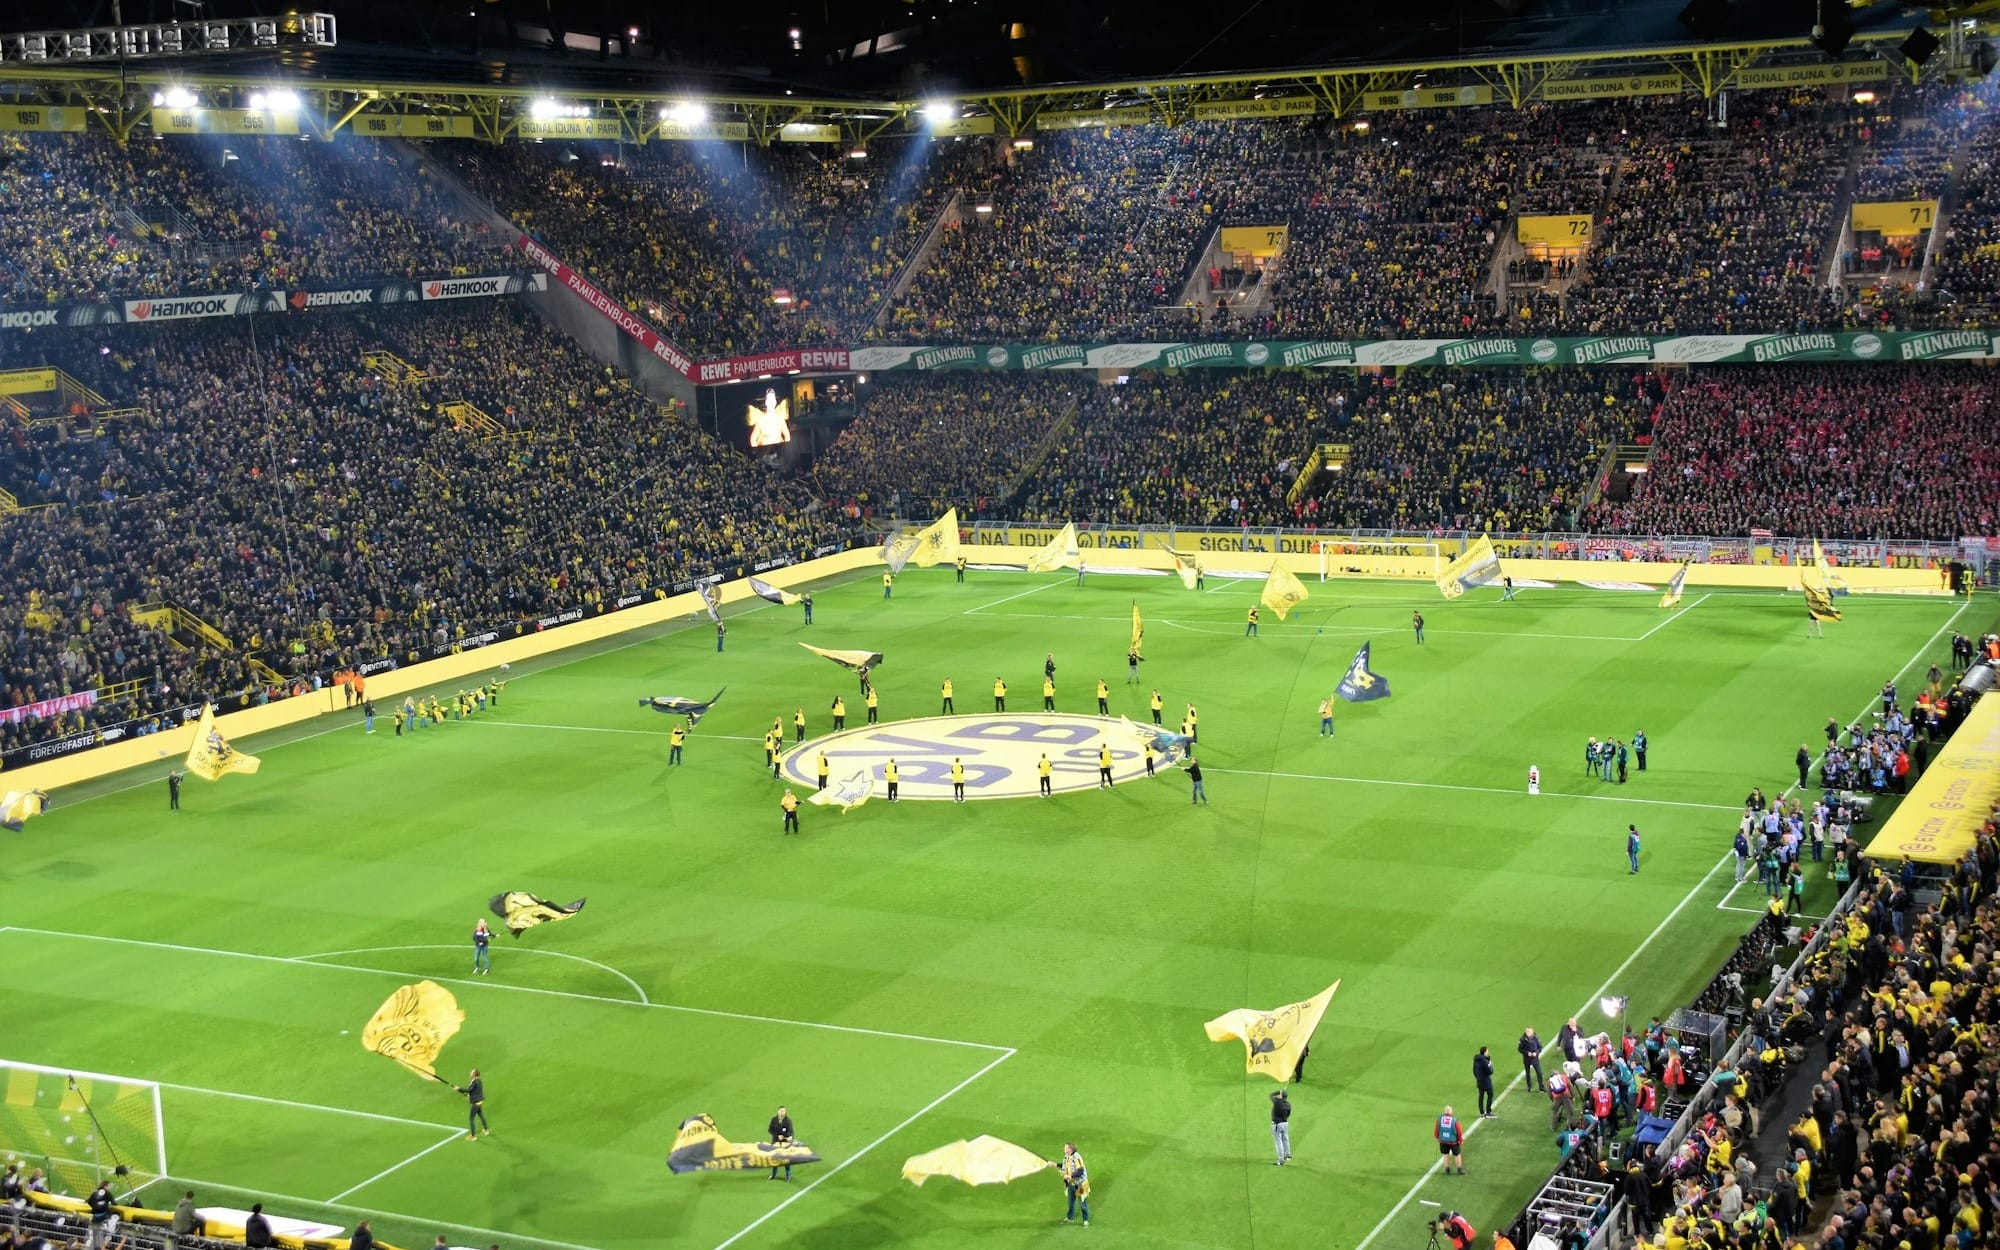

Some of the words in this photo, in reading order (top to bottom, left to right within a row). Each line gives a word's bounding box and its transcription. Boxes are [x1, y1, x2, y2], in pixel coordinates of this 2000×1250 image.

[1741, 74, 1784, 85] SIGNAL
[1788, 70, 1825, 81] IDUNA
[1850, 66, 1883, 77] PARK
[1547, 85, 1587, 95] SIGNAL
[1590, 83, 1624, 93] IDUNA
[1647, 79, 1678, 89] PARK
[1198, 105, 1232, 115] SIGNAL
[1236, 103, 1265, 113] IDUNA
[1286, 101, 1312, 111] PARK
[16, 111, 40, 124] 1957
[172, 115, 193, 127] 1963
[243, 116, 263, 128] 1965
[521, 123, 553, 134] SIGNAL
[555, 123, 581, 134] IDUNA
[597, 124, 620, 135] PARK
[1910, 207, 1930, 223] 71
[1568, 221, 1588, 235] 72
[525, 241, 561, 276] REWE
[568, 275, 646, 341] FAMILIENBLOCK
[654, 340, 692, 375] REWE
[701, 362, 731, 381] REWE
[734, 355, 796, 375] FAMILIENBLOCK
[801, 351, 848, 367] REWE
